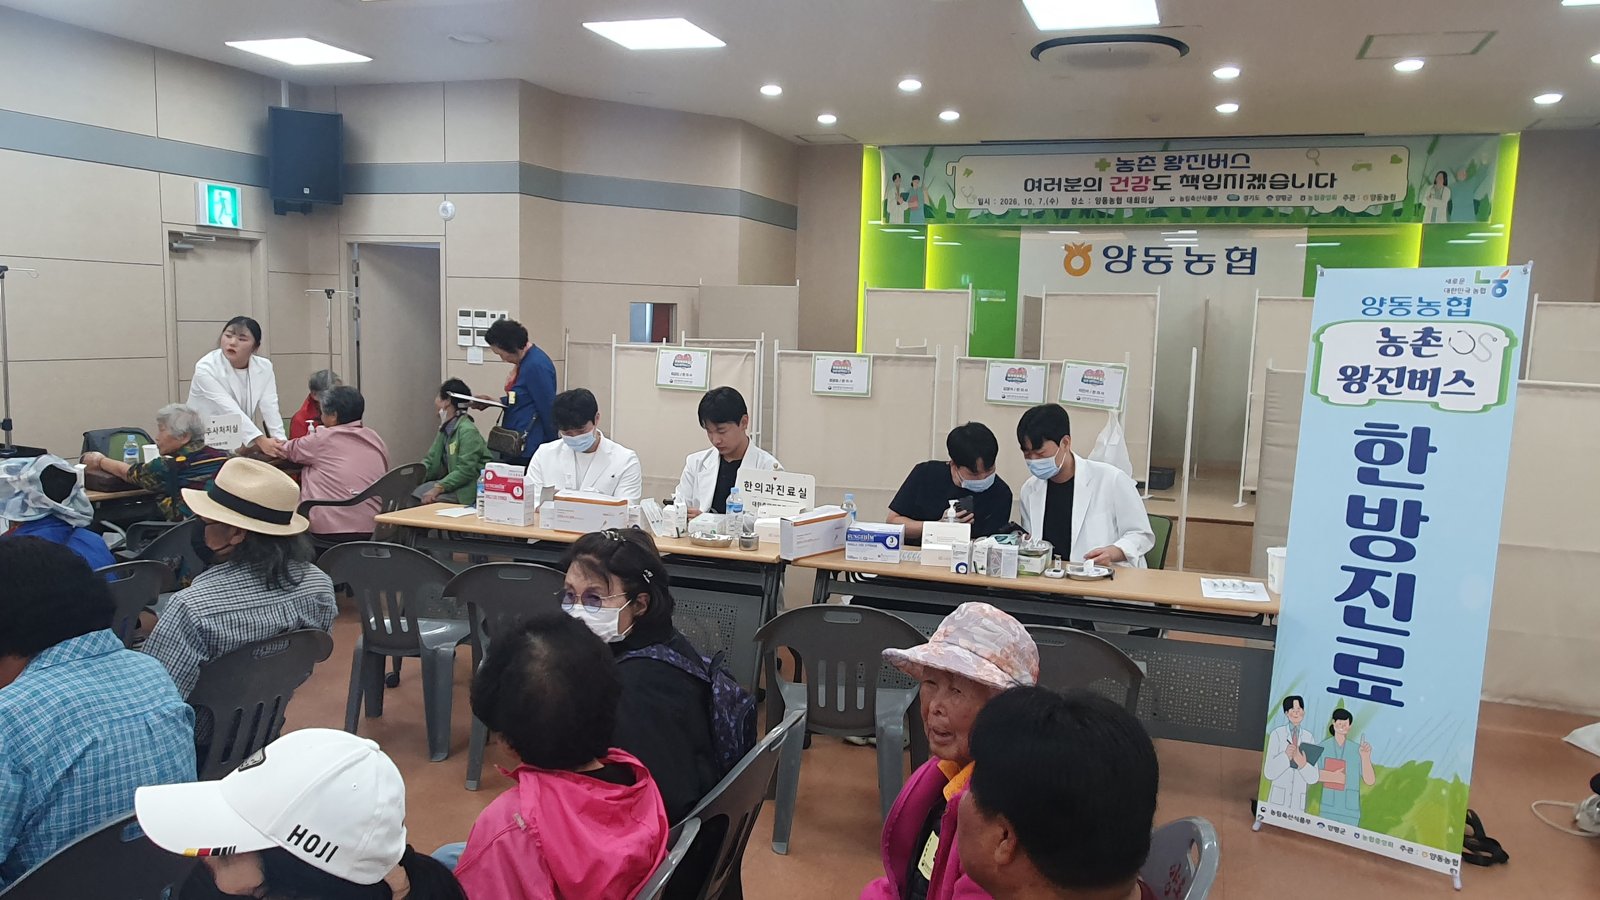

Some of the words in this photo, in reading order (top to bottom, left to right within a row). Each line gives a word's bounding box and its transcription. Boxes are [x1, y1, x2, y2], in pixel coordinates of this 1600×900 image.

[1115, 155, 1157, 173] 농촌
[1163, 153, 1251, 171] 왕진버스
[1023, 177, 1103, 192] 여러분의
[1109, 174, 1172, 192] 건강도
[1179, 172, 1338, 190] 책임지겠습니다
[977, 198, 991, 206] 일시
[1071, 197, 1084, 205] 장소
[1095, 196, 1123, 205] 양동농협
[1126, 195, 1155, 204] 대회의실
[1102, 245, 1257, 275] 양동농협
[1361, 296, 1472, 317] 양동농협
[1376, 326, 1443, 358] 농촌
[1336, 364, 1476, 398] 왕진버스
[205, 424, 239, 435] 주사처치실
[743, 480, 807, 499] 한의과진료실
[1326, 422, 1438, 708] 한방진료
[286, 823, 339, 863] HOJI
[1399, 844, 1414, 855] 주관
[1429, 852, 1459, 867] 양동농협
